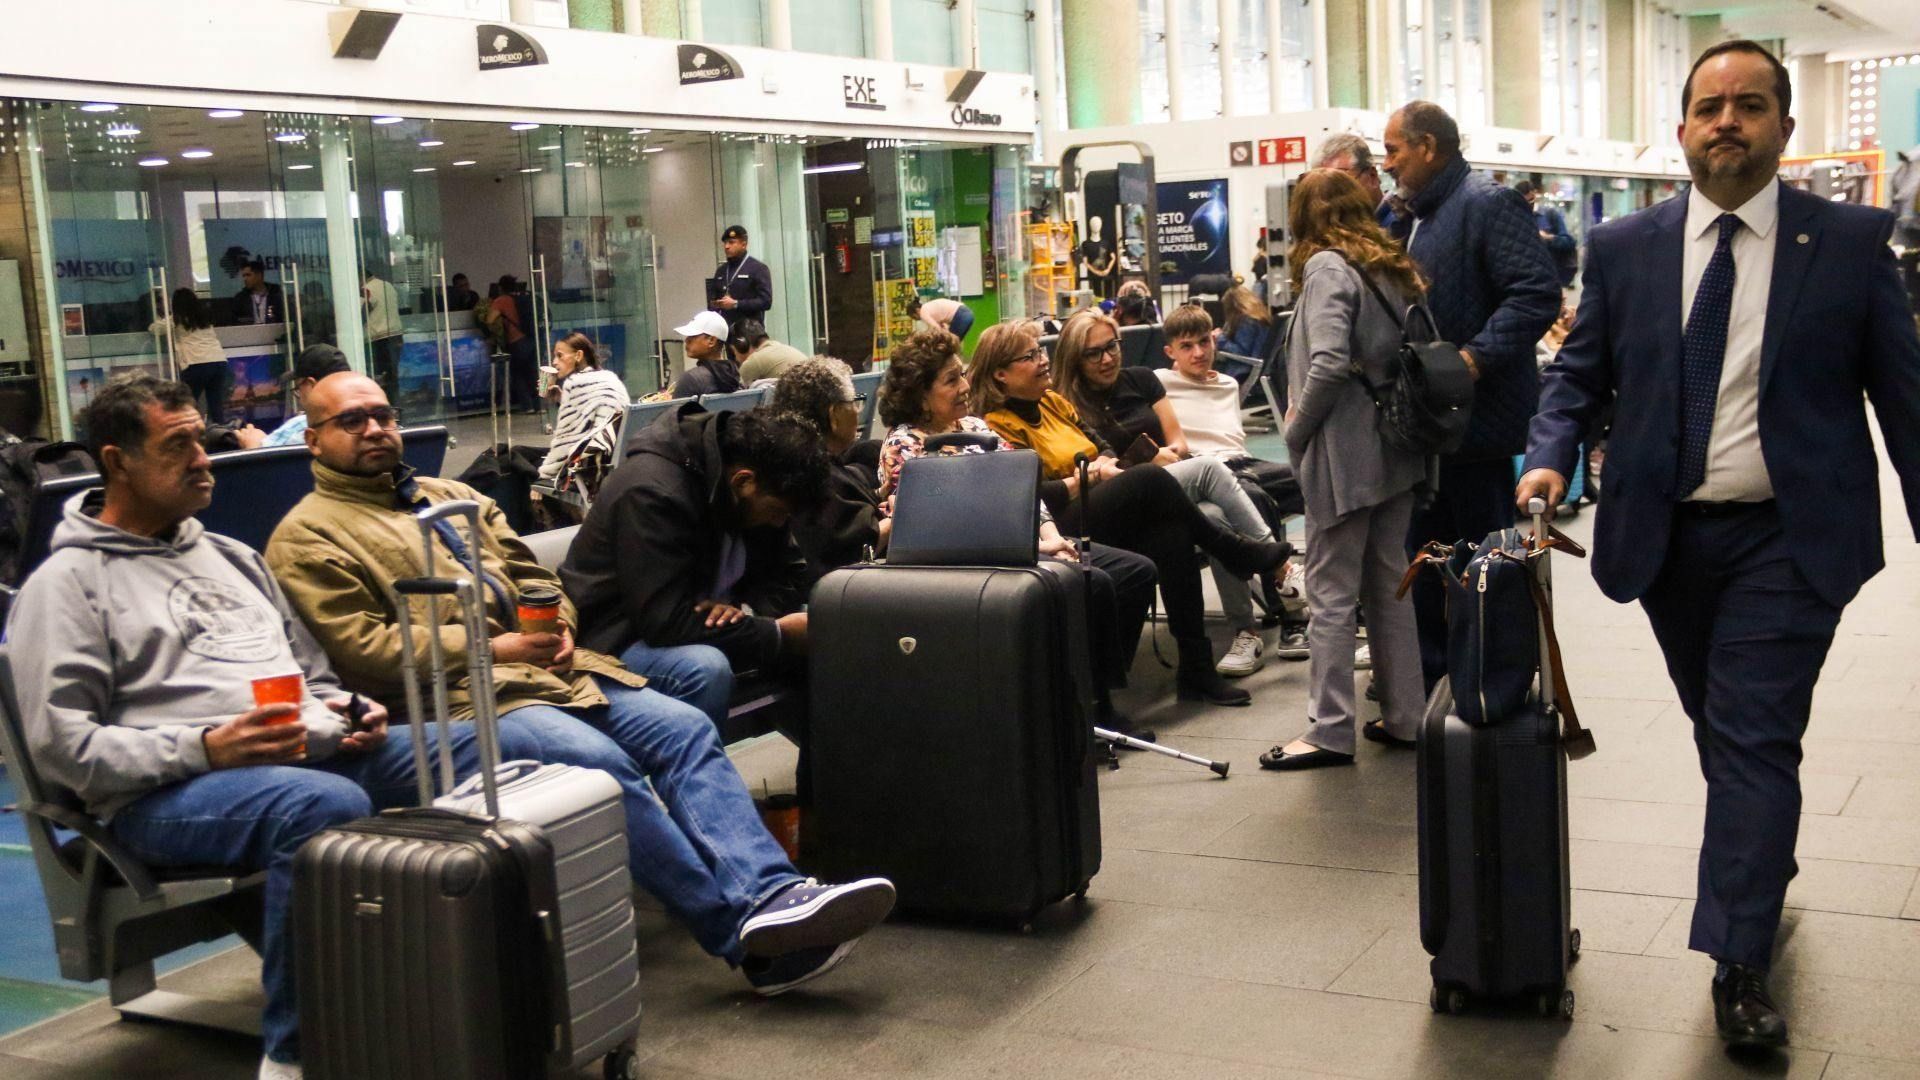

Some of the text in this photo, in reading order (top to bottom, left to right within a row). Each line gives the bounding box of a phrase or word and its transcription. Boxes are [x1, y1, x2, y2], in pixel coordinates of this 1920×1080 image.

[843, 75, 877, 103] EXE
[1165, 225, 1194, 234] MARCA
[1166, 234, 1195, 243] LENTES
